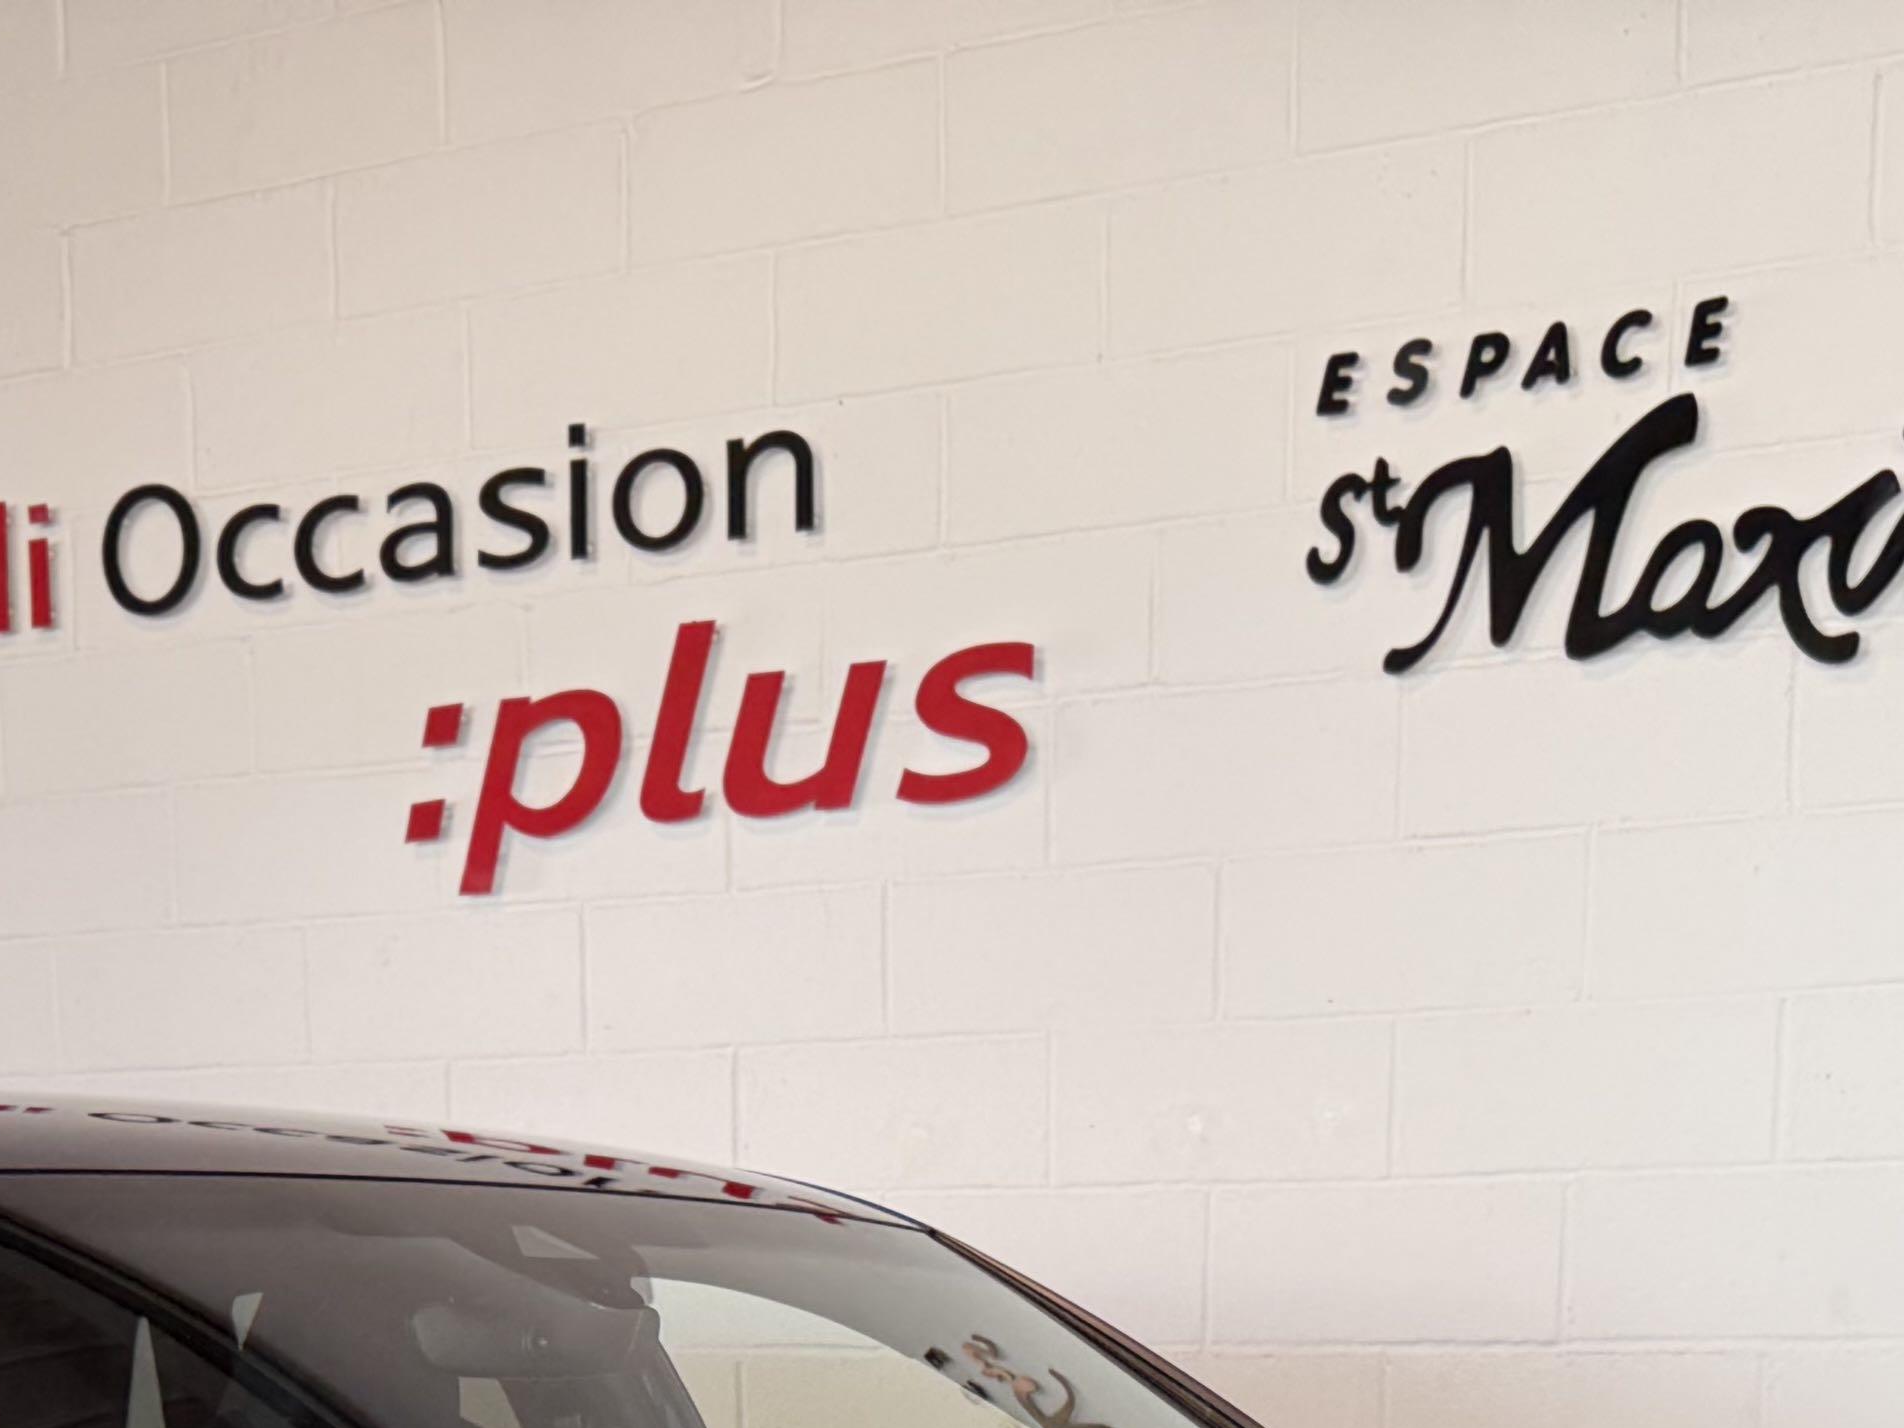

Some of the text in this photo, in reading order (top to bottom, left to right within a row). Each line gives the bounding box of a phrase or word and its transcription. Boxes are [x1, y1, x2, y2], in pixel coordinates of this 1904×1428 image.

[1315, 295, 1730, 416] ESPACE
[100, 423, 819, 618] Occasion
[1306, 456, 1404, 586] St
[404, 619, 1037, 896] :plus
